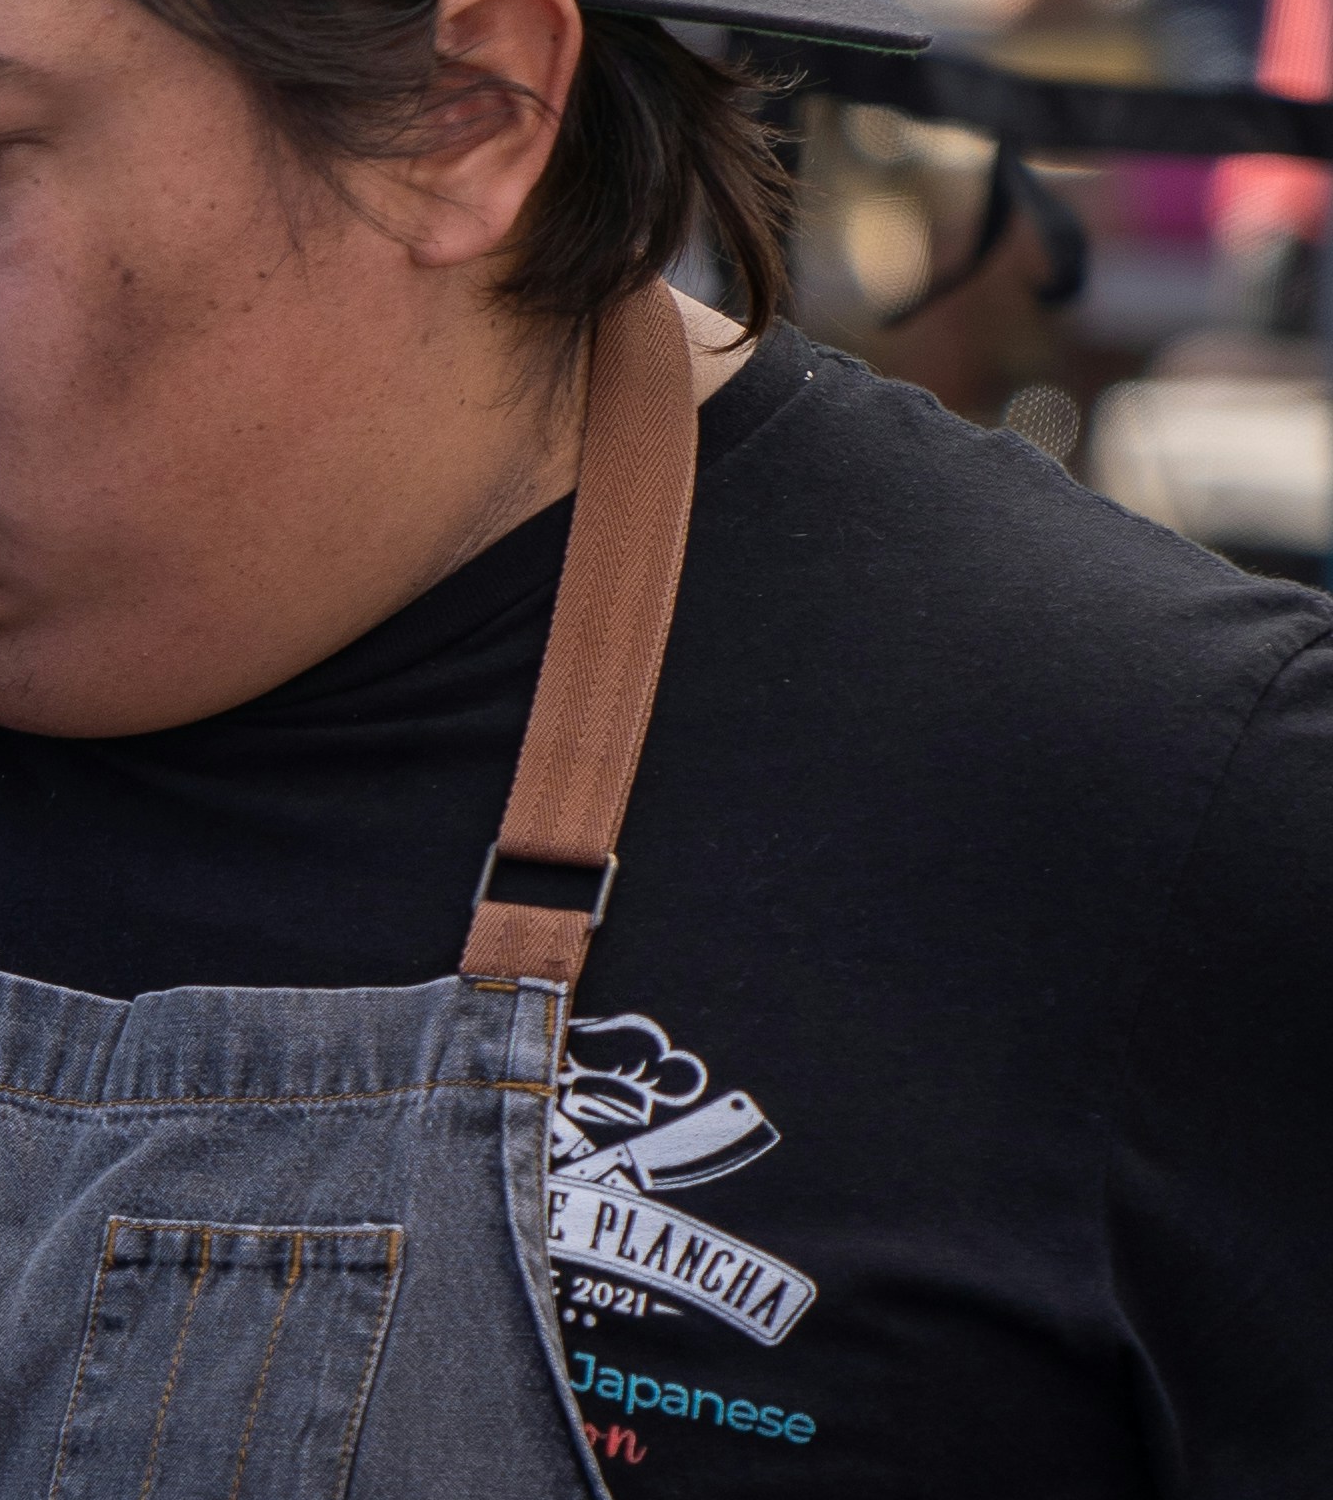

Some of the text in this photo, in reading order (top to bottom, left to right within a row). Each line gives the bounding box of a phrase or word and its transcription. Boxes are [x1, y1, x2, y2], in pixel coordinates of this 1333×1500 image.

[570, 1276, 648, 1317] 2021
[589, 1200, 789, 1328] PLANCHA
[570, 1351, 817, 1444] Japanese
